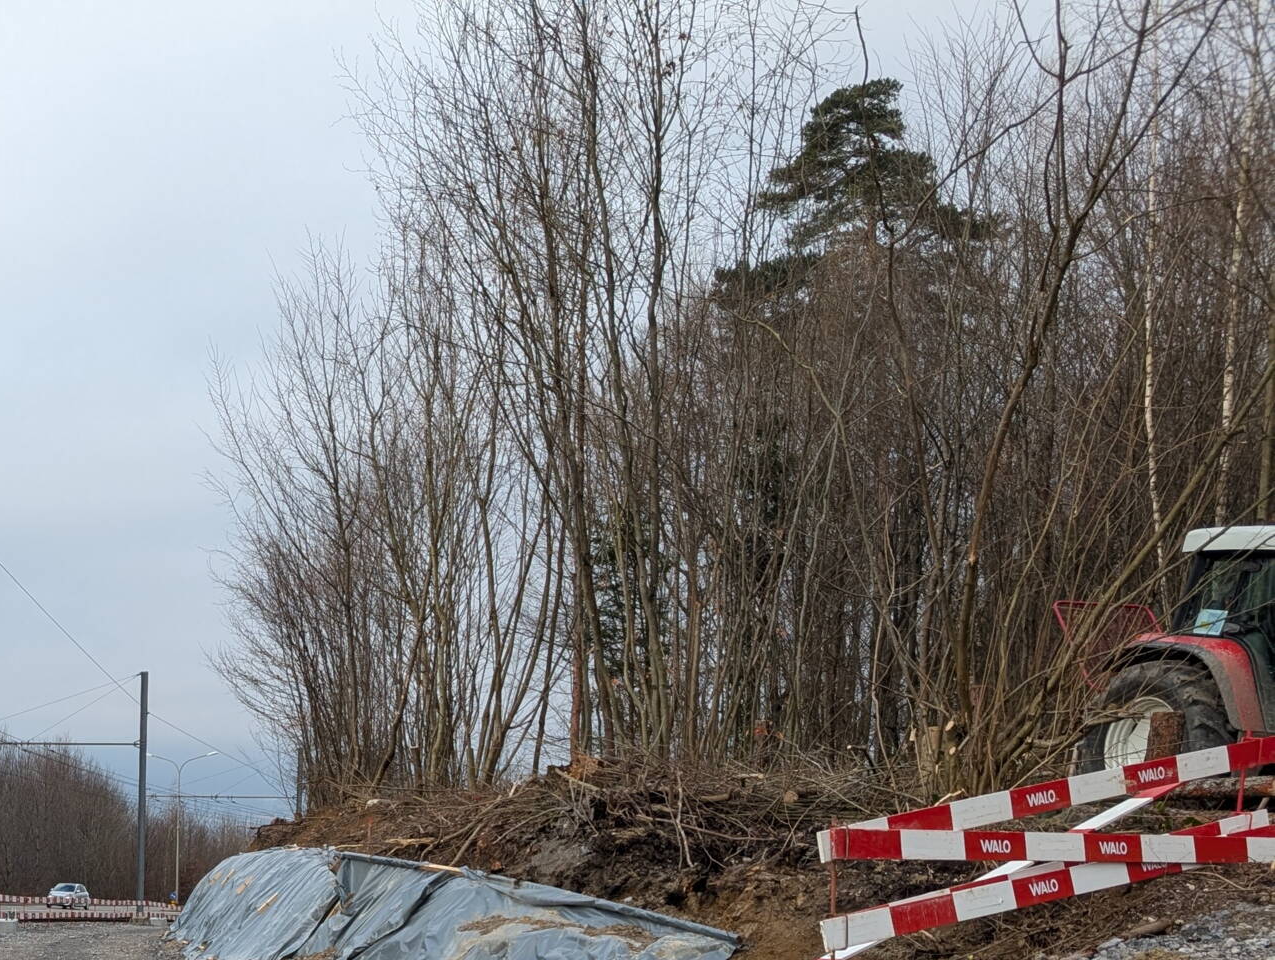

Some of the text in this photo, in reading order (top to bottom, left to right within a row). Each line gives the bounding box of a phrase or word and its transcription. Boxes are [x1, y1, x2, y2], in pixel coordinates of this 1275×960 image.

[1137, 766, 1165, 783] WALO
[1026, 789, 1056, 807] WALO
[979, 839, 1010, 853] WALO
[1098, 841, 1127, 854] WALO
[1028, 878, 1058, 896] WALO
